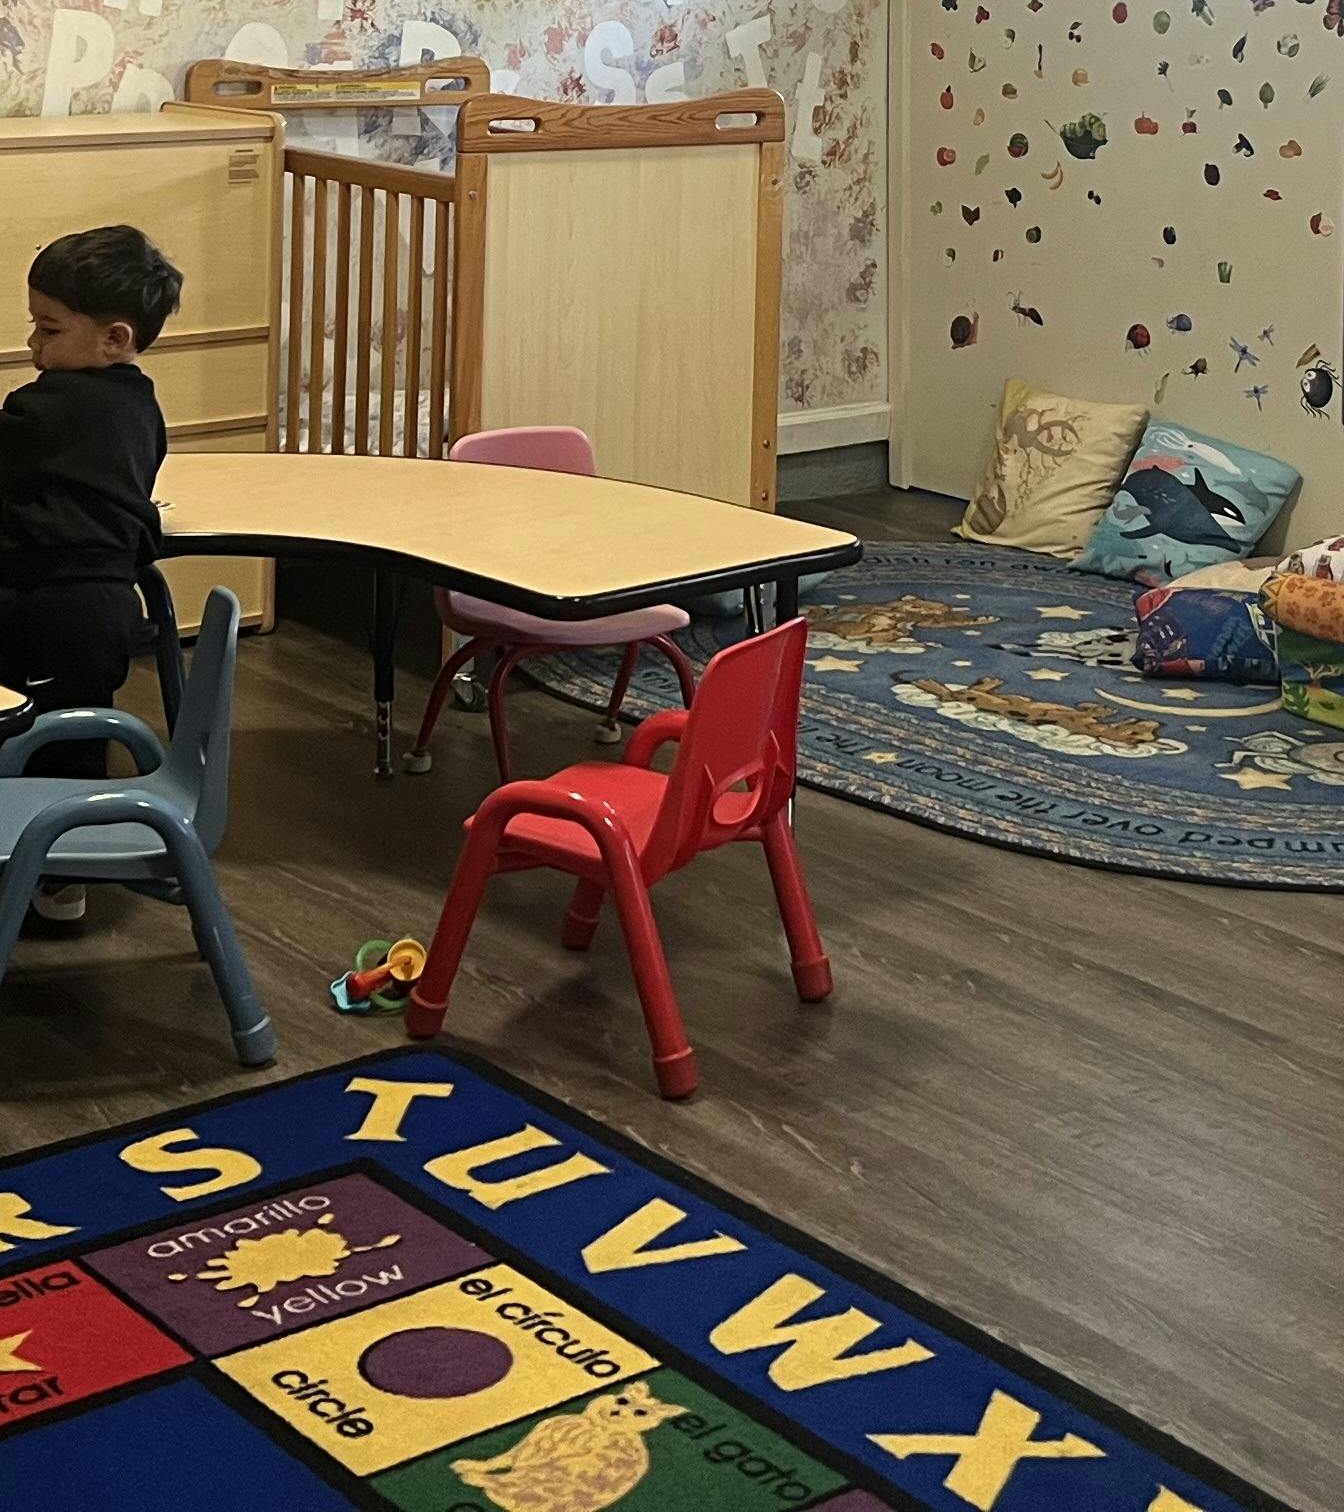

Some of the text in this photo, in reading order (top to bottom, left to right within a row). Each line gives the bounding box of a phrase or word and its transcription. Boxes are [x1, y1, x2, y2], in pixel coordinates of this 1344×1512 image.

[895, 757, 994, 792] moon
[996, 789, 1058, 816] the
[1059, 806, 1164, 838] over
[118, 1127, 263, 1202] S
[343, 1075, 455, 1141] T
[145, 1187, 333, 1264] amarillo
[248, 1258, 407, 1330] yellow
[422, 1123, 1108, 1512] U V W X
[457, 1270, 626, 1381] el círculo
[268, 1360, 379, 1445] circle
[670, 1409, 816, 1504] el gato
